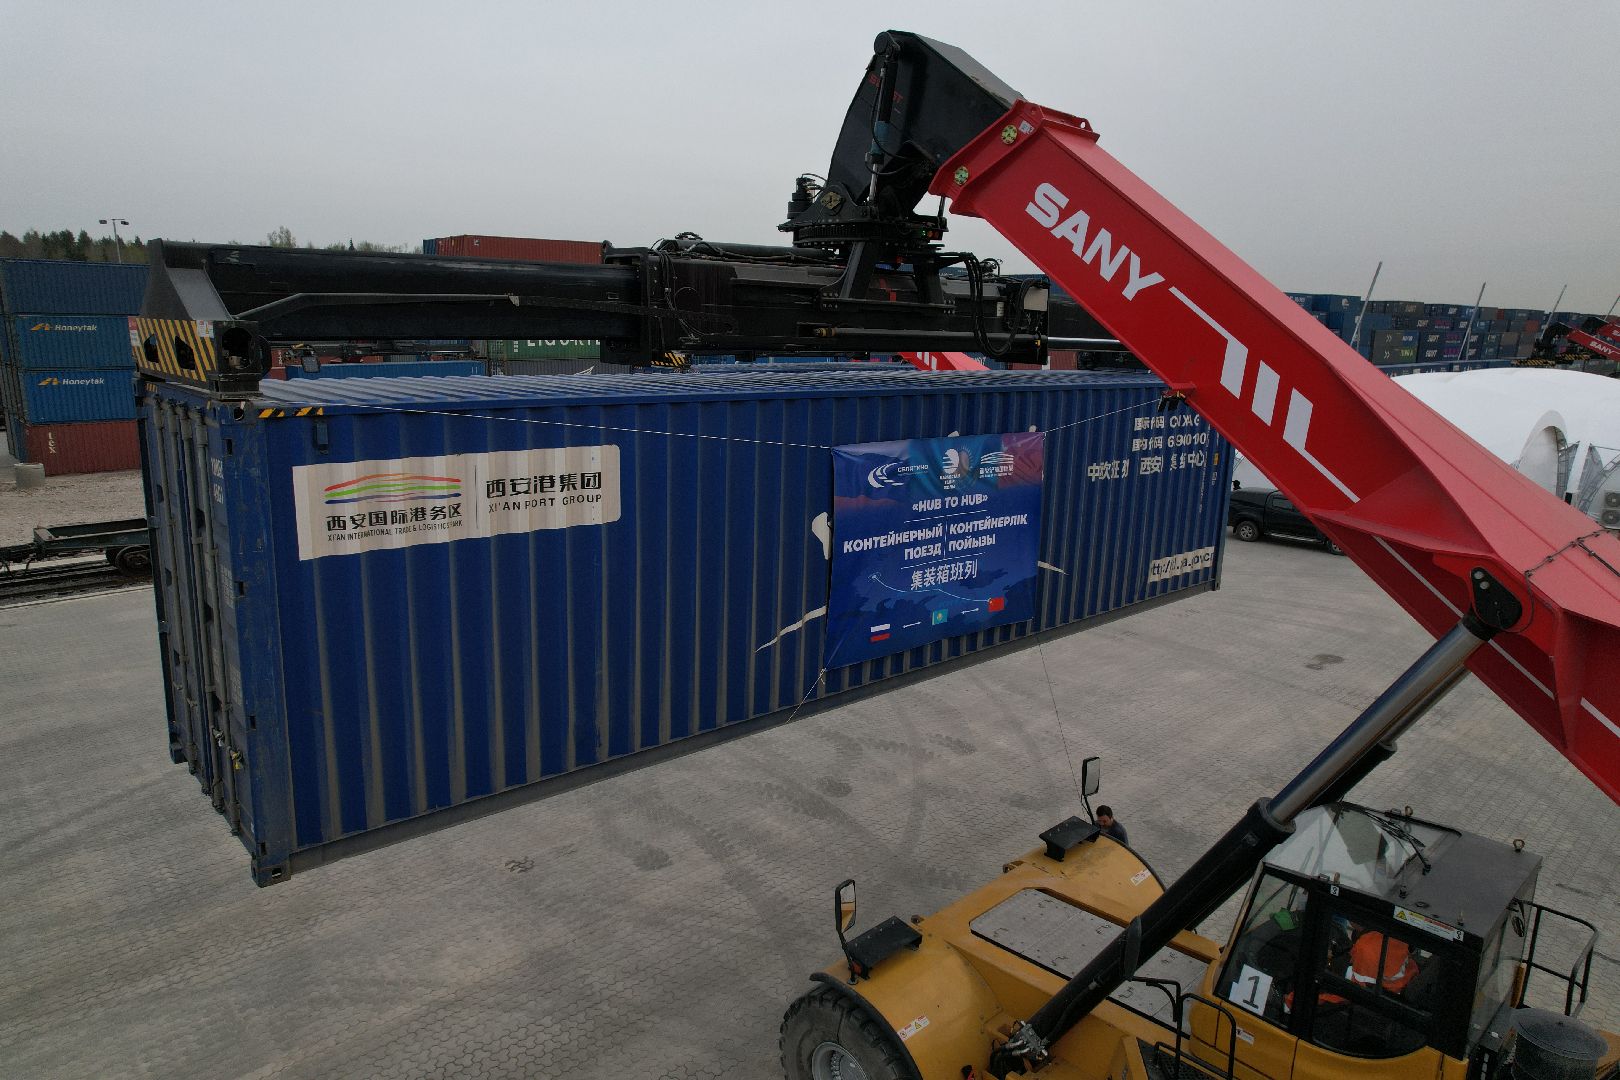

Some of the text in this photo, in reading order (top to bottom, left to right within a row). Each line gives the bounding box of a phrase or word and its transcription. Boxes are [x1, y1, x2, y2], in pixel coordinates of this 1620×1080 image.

[1025, 183, 1166, 301] SANY
[486, 472, 602, 499] 西安港集团
[488, 494, 602, 513] XI'AN PORT GROUP
[944, 496, 959, 509] TO
[326, 503, 462, 531] 西安国际港务区
[843, 523, 943, 554] КОНТЕЙНЕРНЫЙ
[904, 542, 942, 561] ПОЕЗД
[910, 559, 979, 591] 集装箱班列
[1242, 975, 1260, 1010] 1
